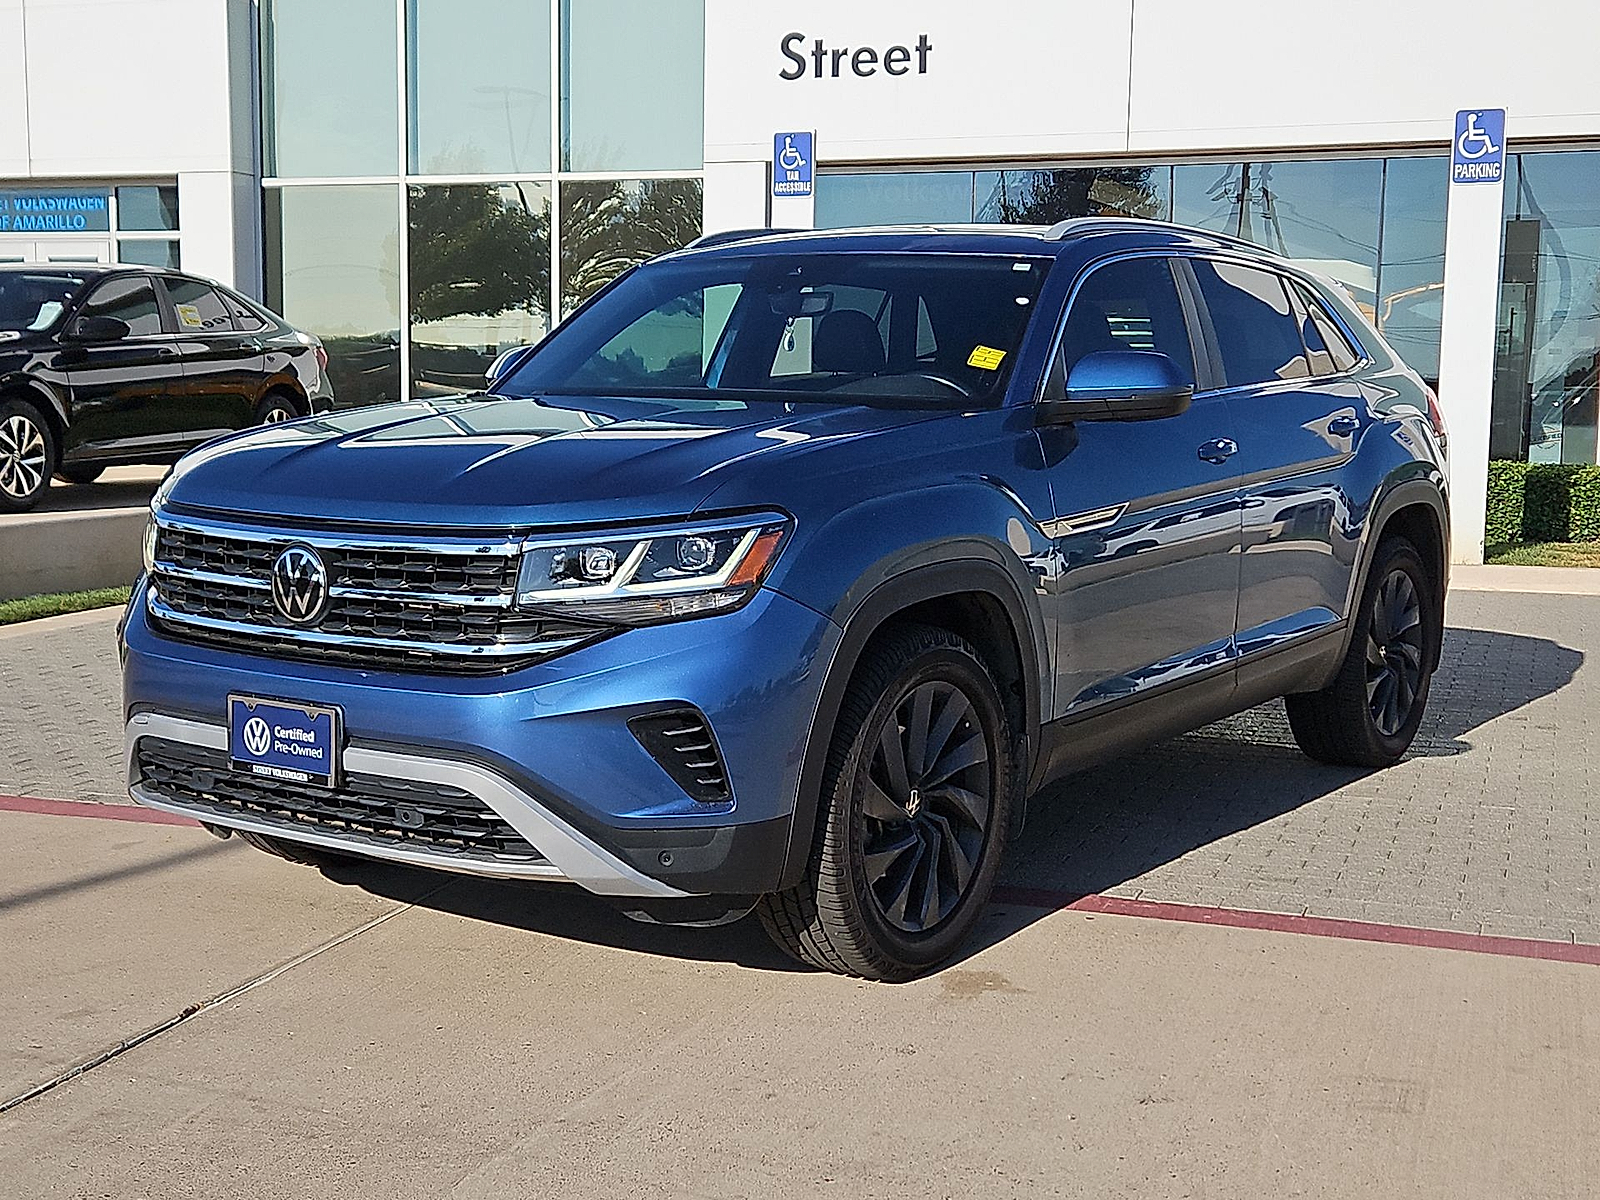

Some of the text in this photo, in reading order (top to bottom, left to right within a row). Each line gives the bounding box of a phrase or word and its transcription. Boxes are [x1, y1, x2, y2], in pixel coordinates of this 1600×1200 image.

[779, 32, 932, 81] Street
[1454, 162, 1501, 179] PARKING
[13, 214, 86, 229] AMARILLO
[275, 726, 315, 743] Certified
[275, 741, 323, 759] Pre-Owned
